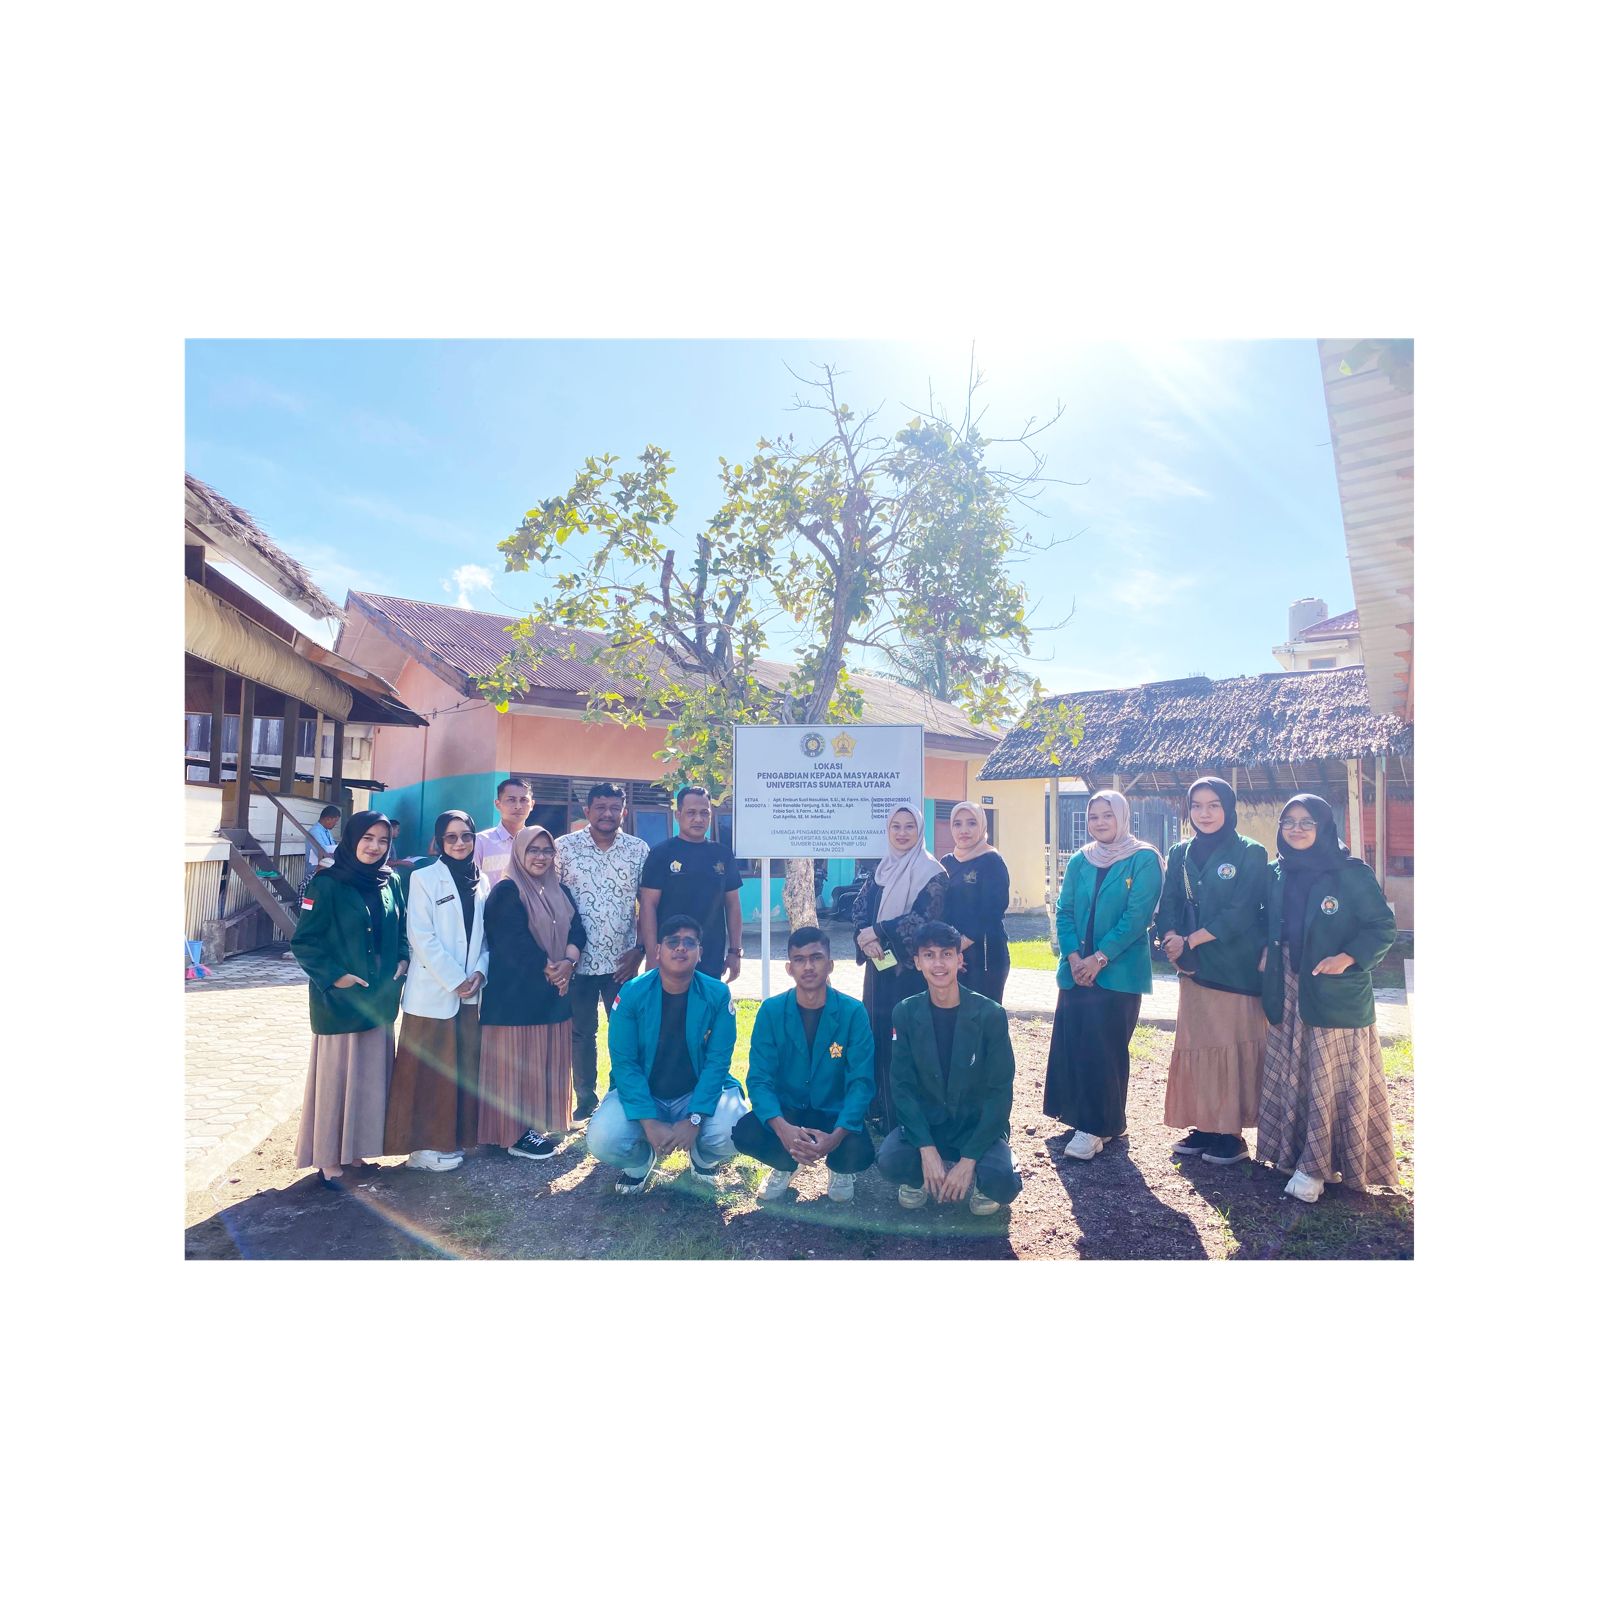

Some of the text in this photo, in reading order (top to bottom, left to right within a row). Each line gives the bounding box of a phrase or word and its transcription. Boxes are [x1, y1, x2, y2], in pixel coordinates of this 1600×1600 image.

[766, 781, 891, 789] UNIVERSITAS SUMATERA UTARA
